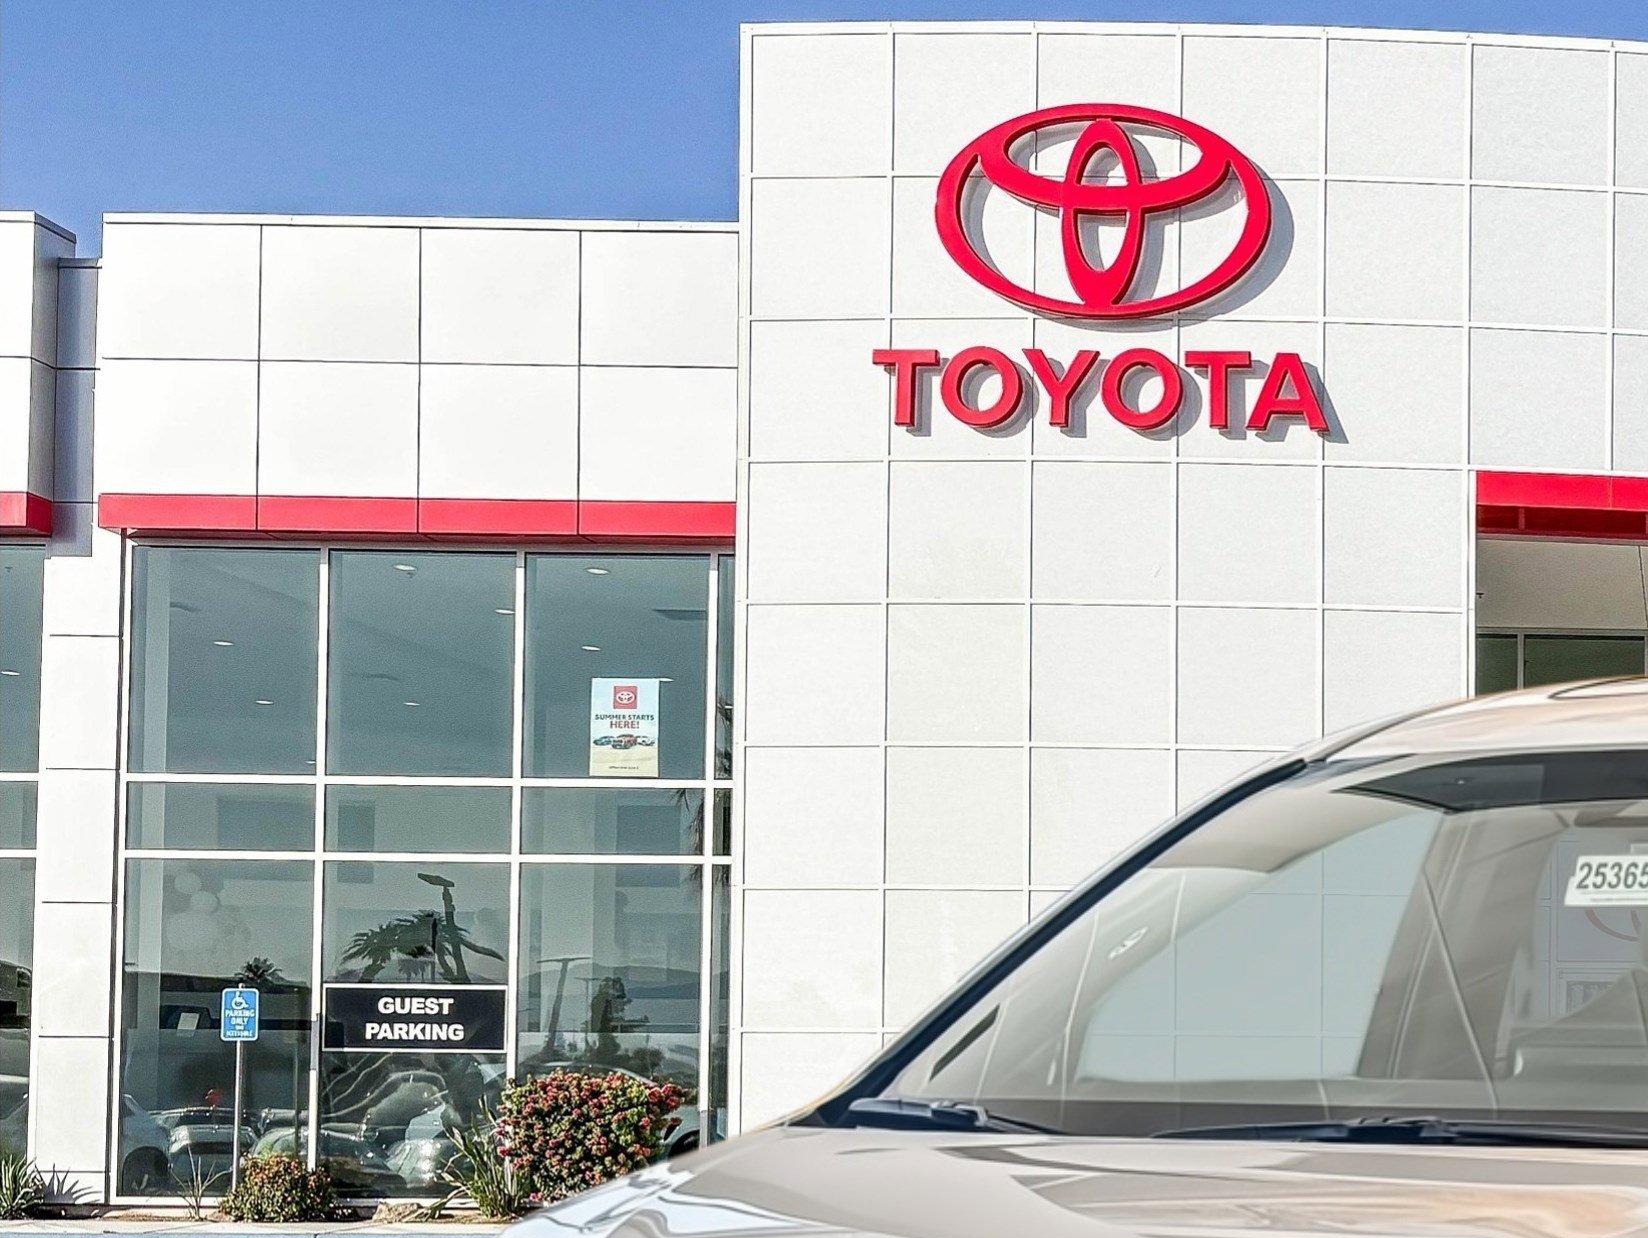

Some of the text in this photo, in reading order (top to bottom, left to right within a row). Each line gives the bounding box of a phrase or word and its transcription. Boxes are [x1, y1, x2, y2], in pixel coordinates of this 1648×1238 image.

[873, 346, 1330, 434] TOYOTA
[609, 720, 640, 729] HERE!
[377, 997, 455, 1015] GUEST
[365, 1022, 465, 1041] PARKING
